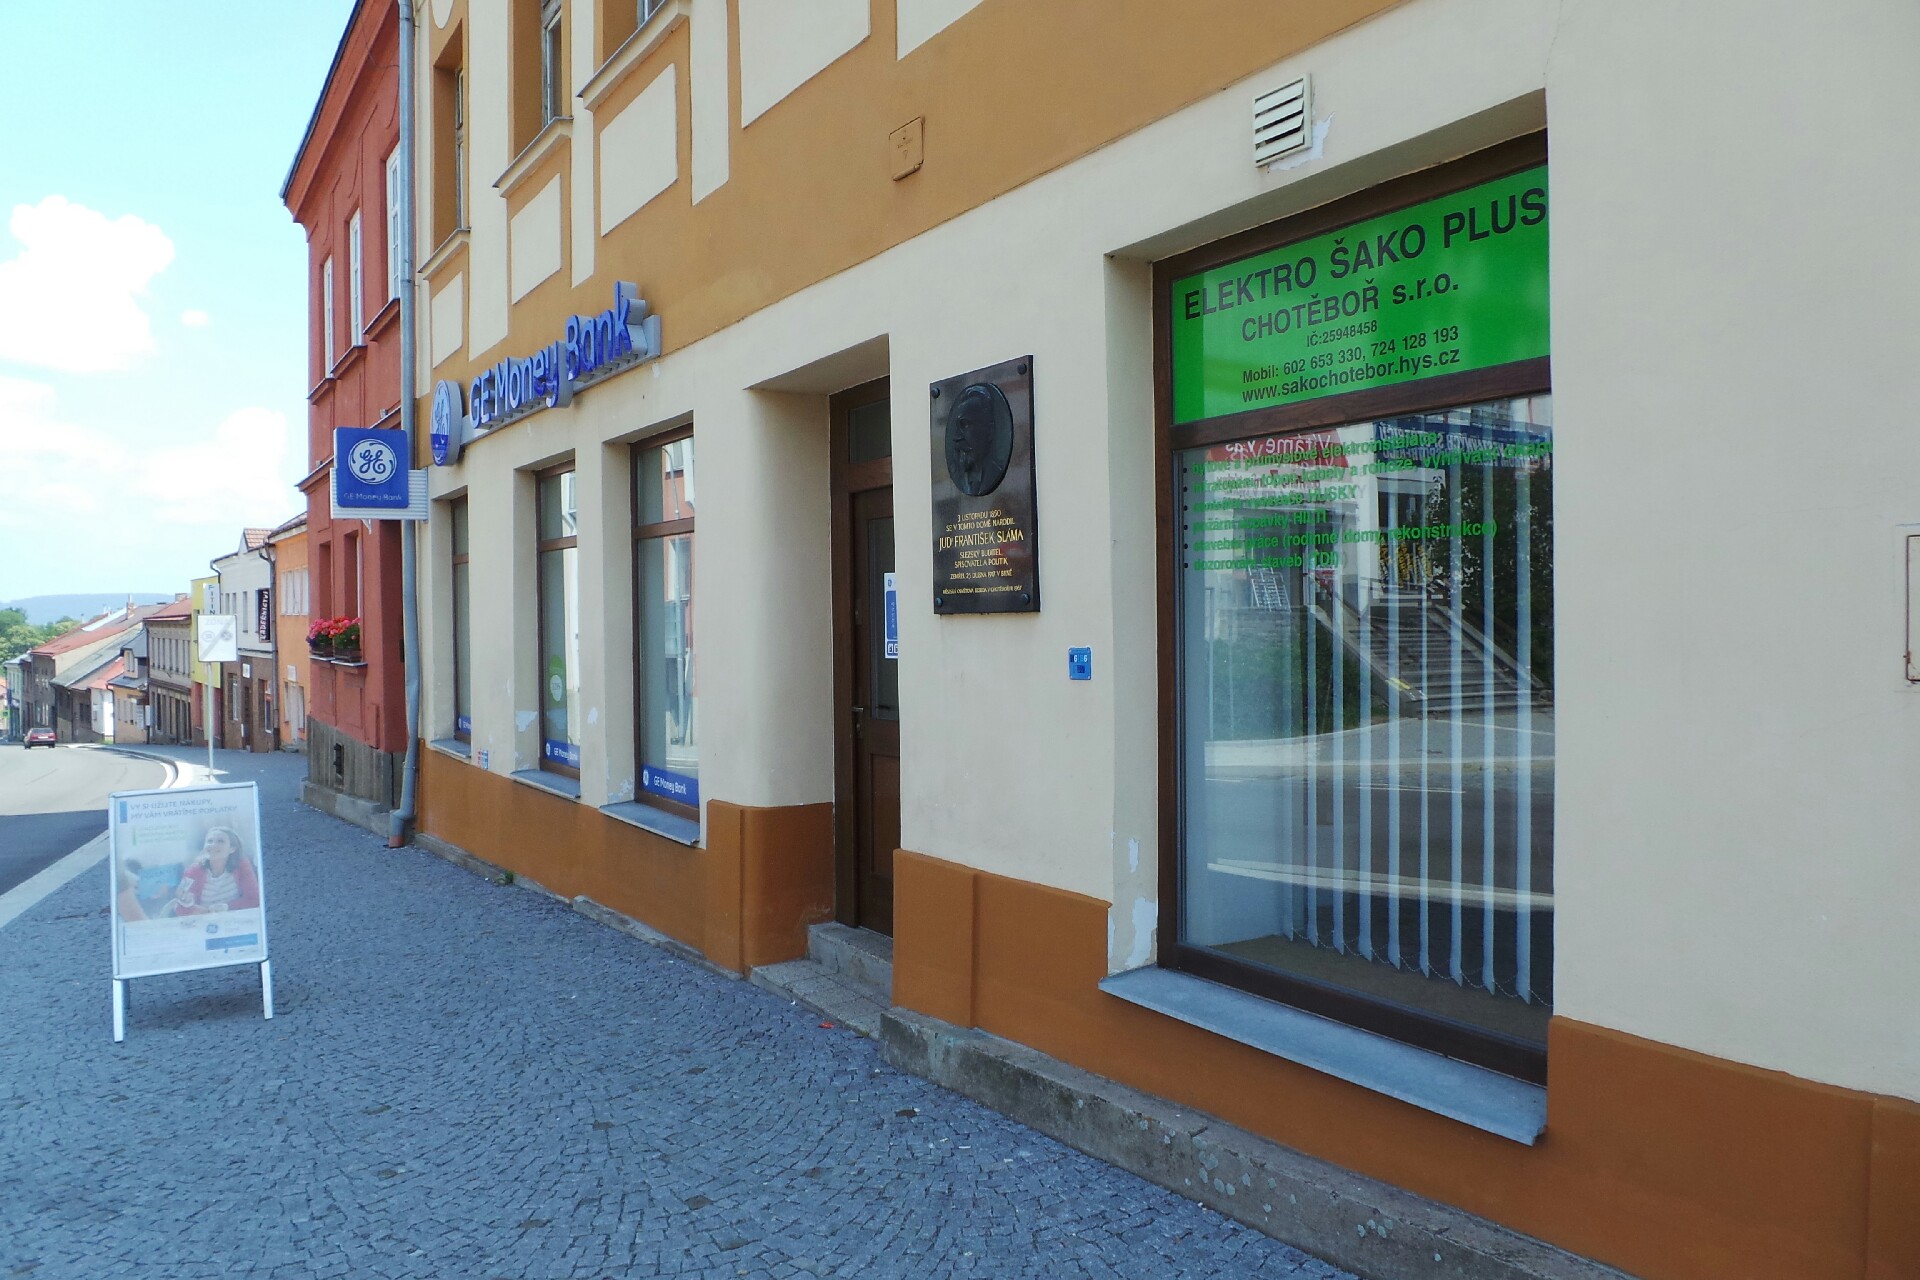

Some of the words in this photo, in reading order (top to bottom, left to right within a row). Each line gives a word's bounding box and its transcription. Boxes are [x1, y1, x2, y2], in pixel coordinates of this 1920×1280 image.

[1185, 256, 1316, 320] ELEKTRO
[1330, 224, 1425, 279] ŠAKO
[1443, 187, 1547, 249] PLUS
[1241, 277, 1379, 342] CHOTĚBOŘ
[1392, 273, 1459, 305] s.r.o.
[469, 368, 492, 429] GE
[494, 340, 560, 408] Money
[565, 280, 633, 381] Bank
[1242, 365, 1279, 384] Mobil:
[1283, 359, 1306, 376] 602
[1310, 353, 1334, 370] 653
[1338, 346, 1366, 364] 330,
[1371, 339, 1396, 357] 724
[1402, 332, 1427, 350] 128
[1433, 325, 1459, 343] 193
[1306, 319, 1378, 348] IČ:25948458
[1241, 348, 1460, 403] www.sakochotebor.hys.cz
[343, 492, 355, 500] GE
[355, 493, 382, 502] Money
[383, 493, 402, 501] Bank
[945, 524, 953, 532] SE
[958, 522, 975, 531] TOMTO
[992, 517, 1016, 527] NARODIL
[954, 531, 996, 548] FRANTIŠEK
[996, 527, 1024, 543] SLÁMA
[653, 775, 660, 787] GE
[660, 777, 675, 794] Money
[675, 781, 687, 795] Bank
